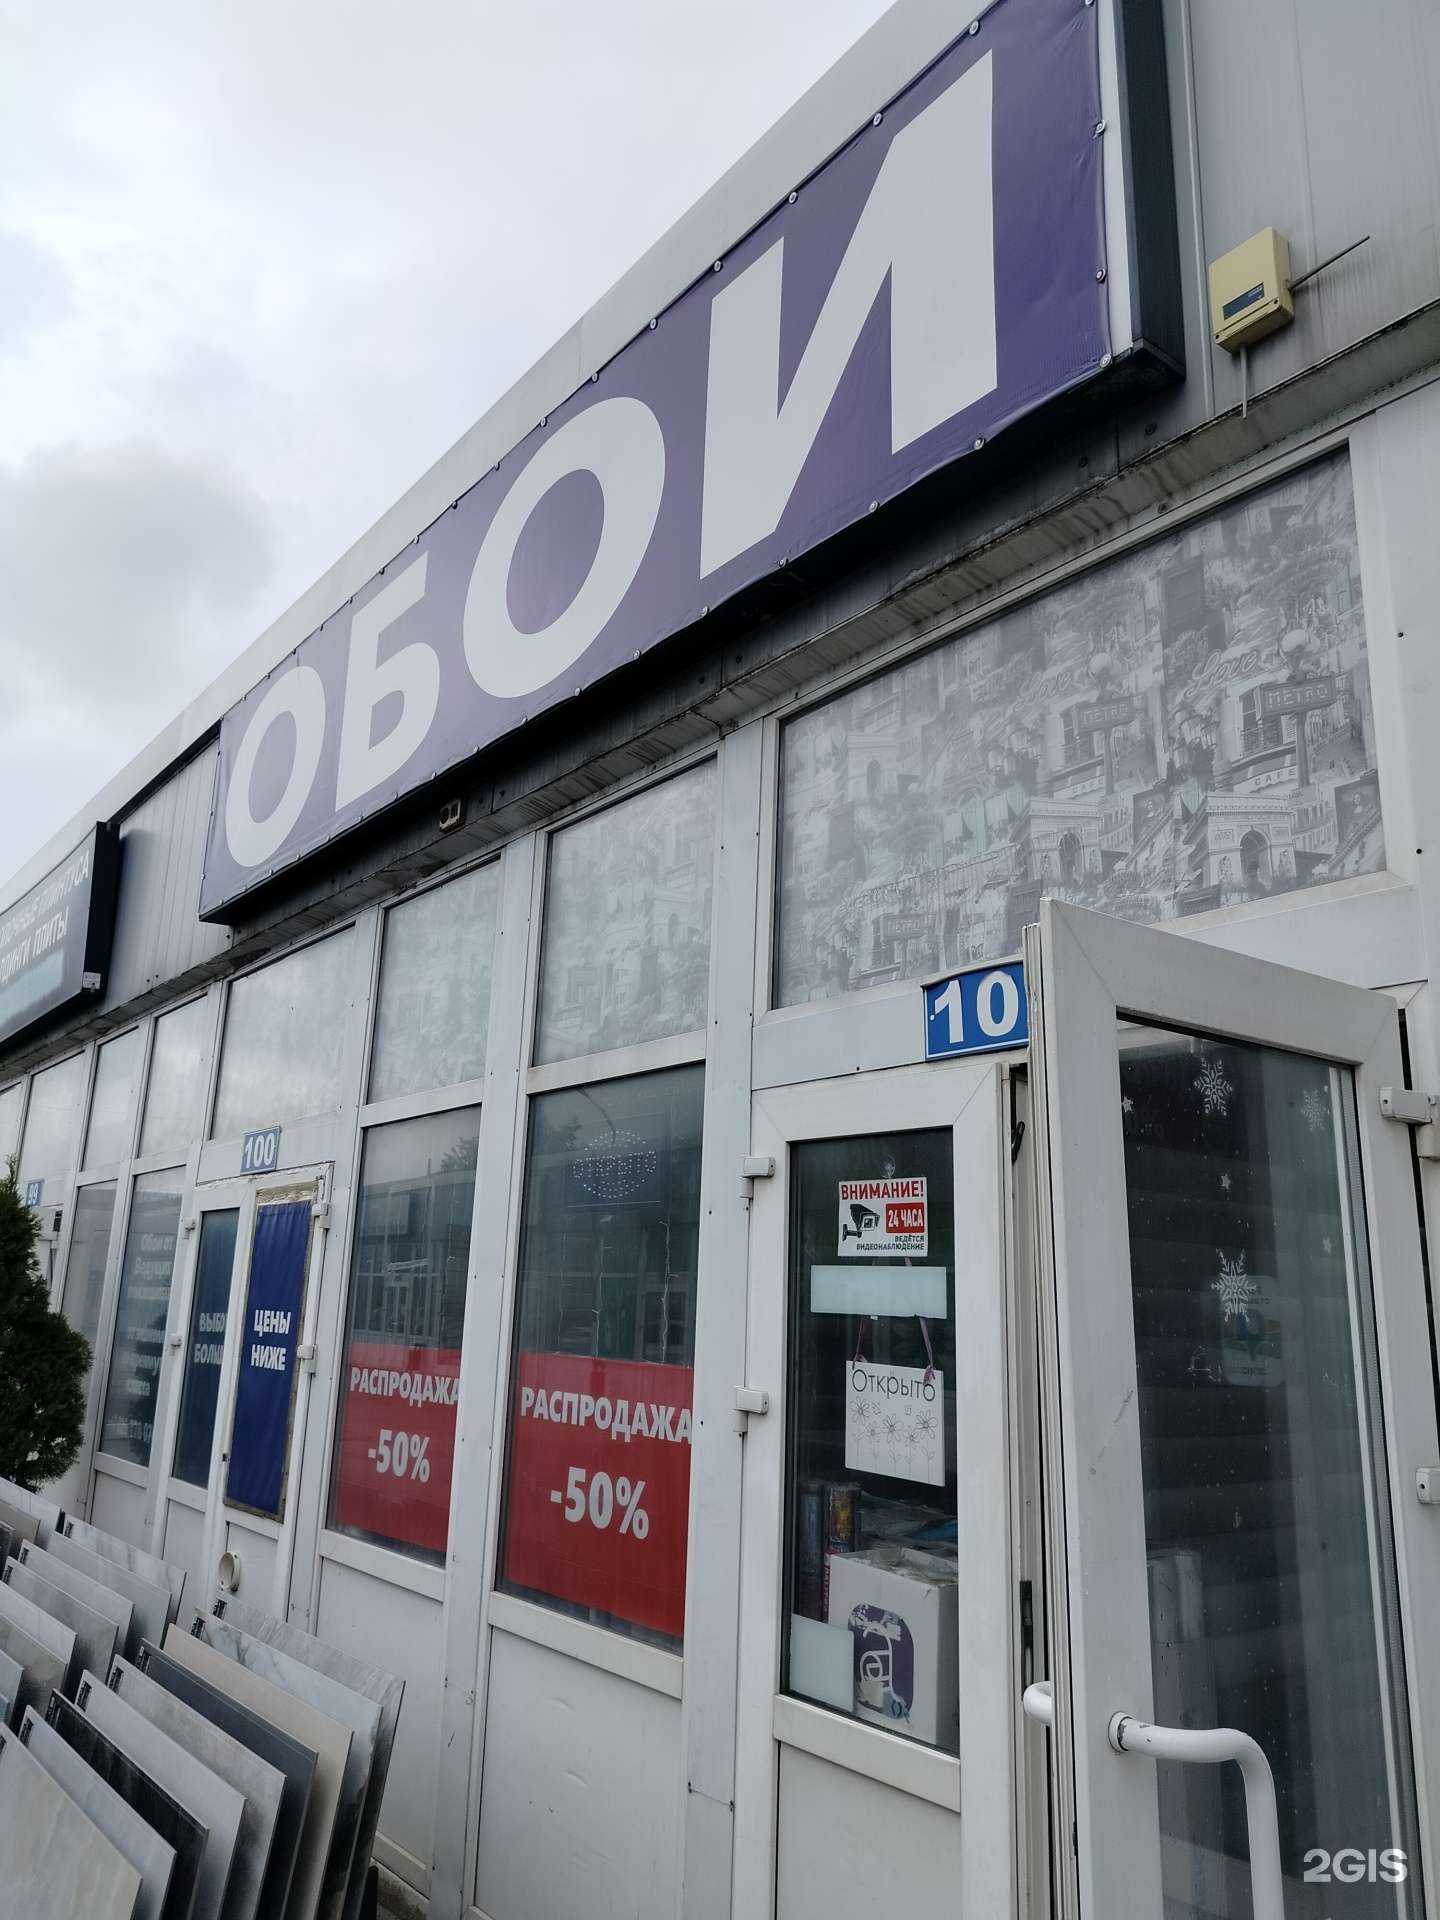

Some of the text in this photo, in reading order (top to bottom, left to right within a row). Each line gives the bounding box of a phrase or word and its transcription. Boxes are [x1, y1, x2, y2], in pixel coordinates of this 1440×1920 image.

[224, 50, 998, 867] ОБОИ
[1268, 683, 1330, 708] METRO
[245, 1133, 276, 1168] 100
[841, 1180, 925, 1201] ВНИМАНИЕ!
[888, 1208, 924, 1228] 24 ЧАСА
[856, 1242, 925, 1251] ВИДЕОНАБЛЮДЕНИЕ
[895, 1234, 924, 1243] ВЕДЁТСЯ
[200, 1312, 227, 1333] ВЫБО
[254, 1309, 291, 1337] ЦЕНЫ
[251, 1344, 286, 1371] НИЖЕ
[350, 1367, 459, 1407] РАСПРОДАЖА
[852, 1369, 936, 1402] Открыто
[521, 1387, 693, 1445] РАСПРОДАЖА
[367, 1429, 430, 1484] -50%
[550, 1466, 650, 1540] -50%
